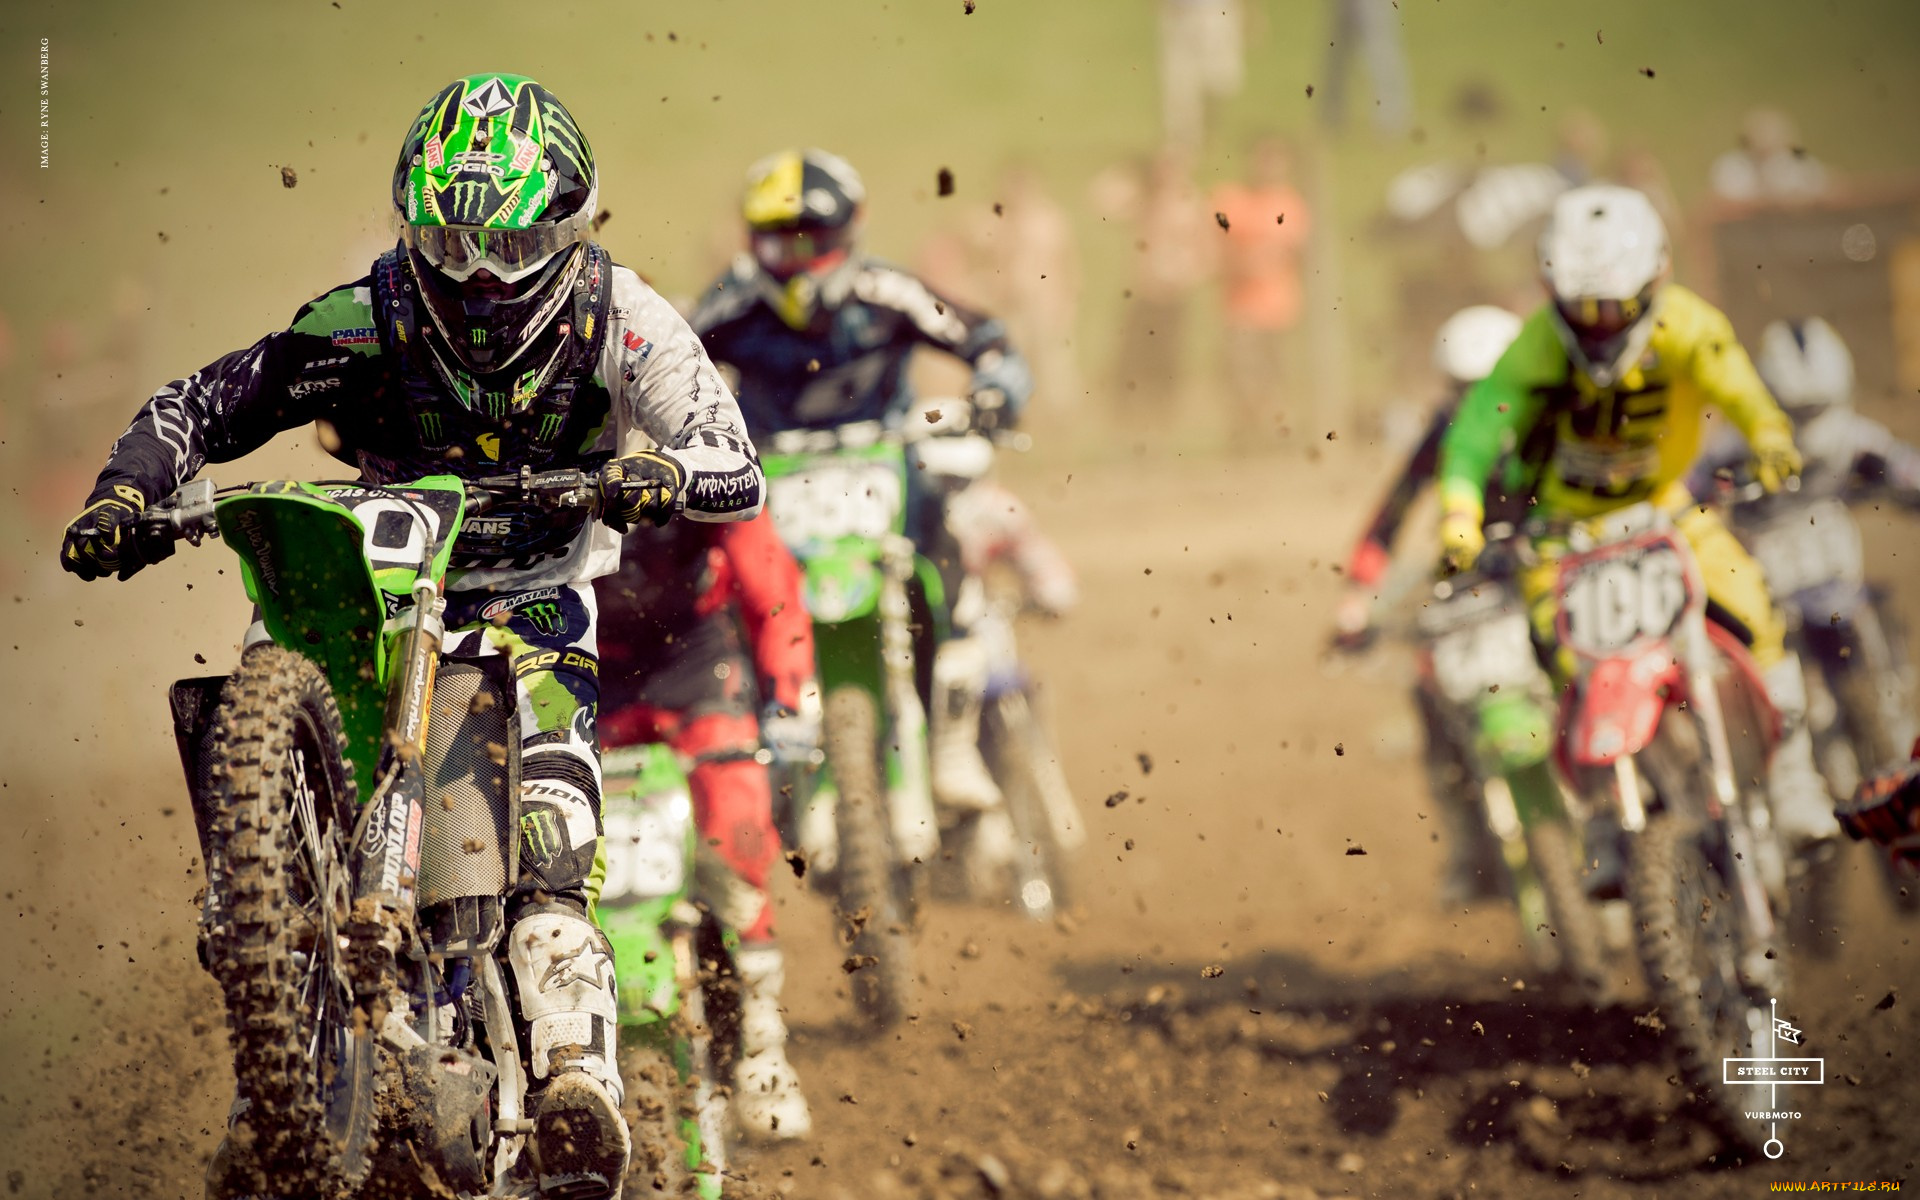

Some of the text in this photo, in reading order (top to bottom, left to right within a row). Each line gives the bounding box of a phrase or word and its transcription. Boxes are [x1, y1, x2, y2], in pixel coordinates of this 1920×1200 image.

[425, 135, 443, 169] VANS
[511, 141, 539, 171] VANS
[446, 162, 506, 178] OGIO
[332, 327, 378, 340] PART
[695, 469, 758, 499] MONSTER
[700, 495, 750, 508] ENERGY
[460, 516, 512, 535] VANS
[516, 651, 599, 678] RO CIR
[521, 784, 588, 808] thor
[381, 791, 405, 897] DUNLOP
